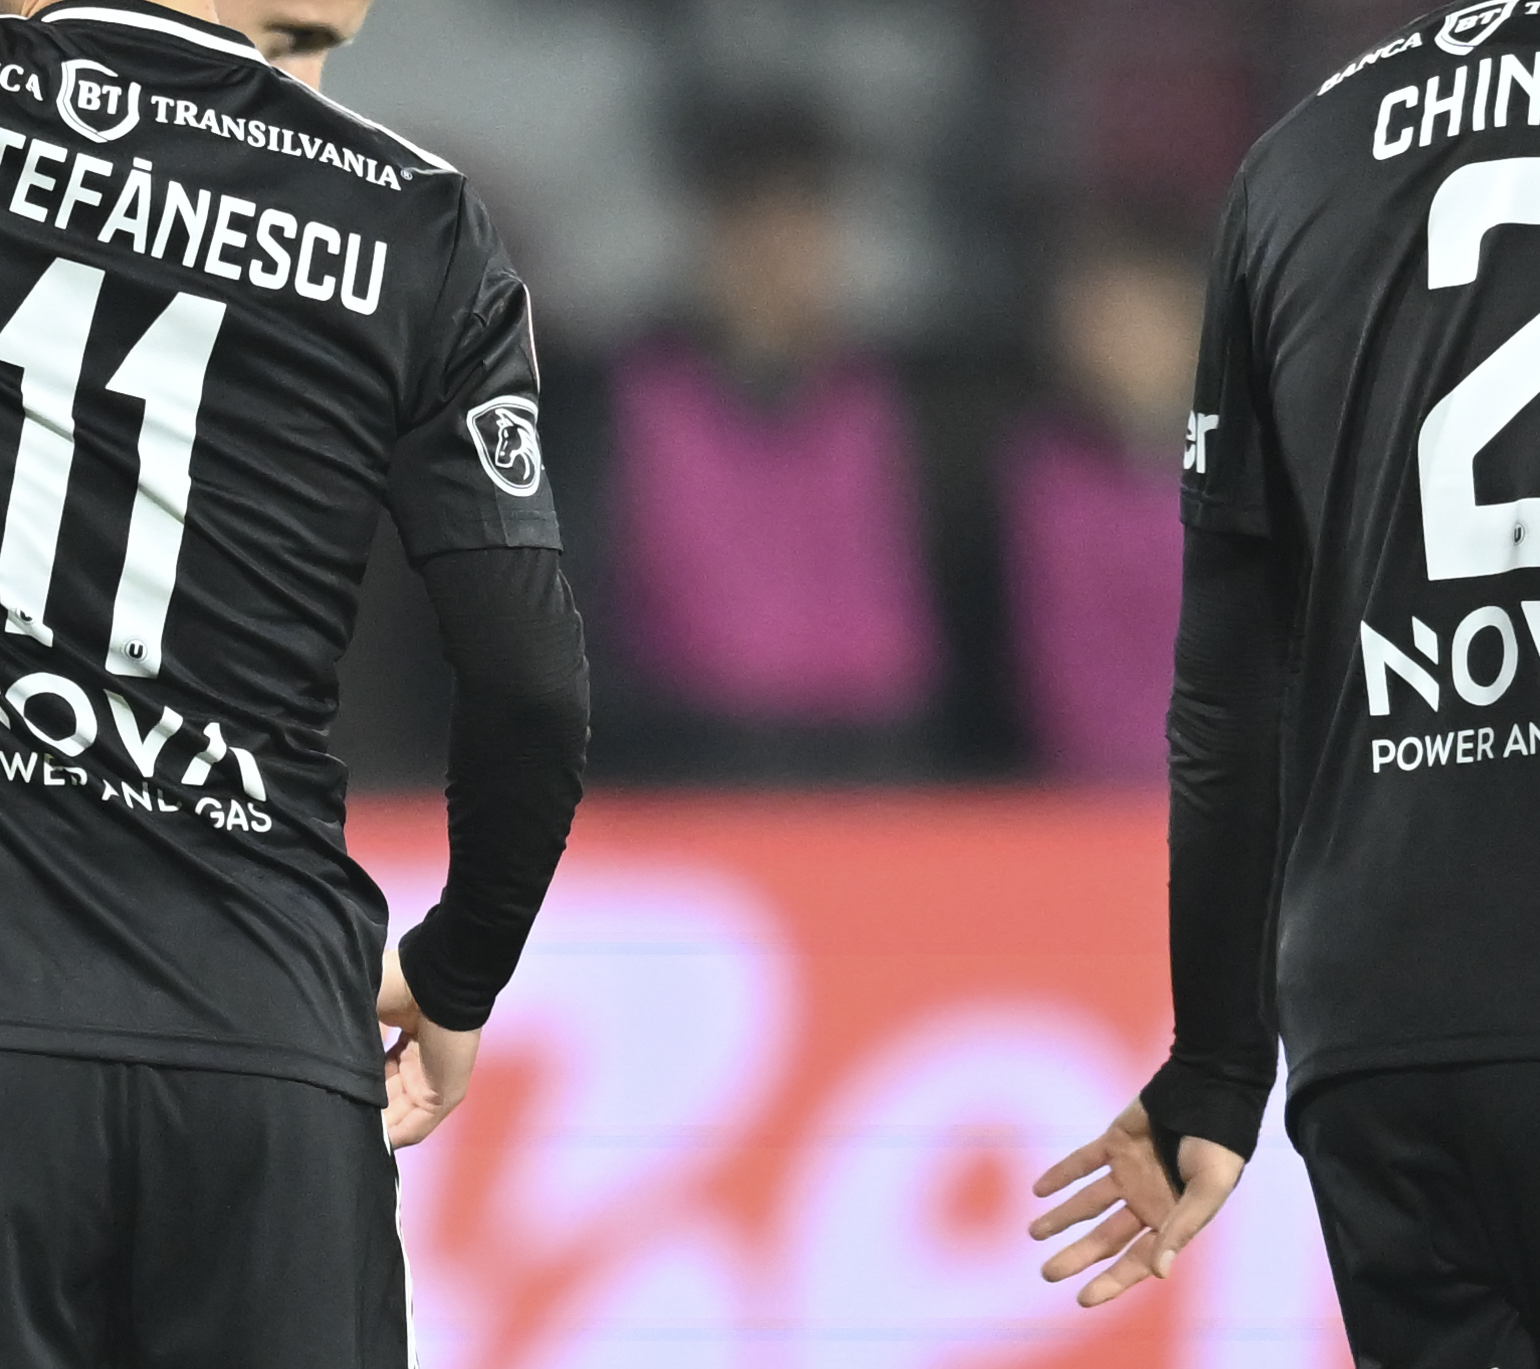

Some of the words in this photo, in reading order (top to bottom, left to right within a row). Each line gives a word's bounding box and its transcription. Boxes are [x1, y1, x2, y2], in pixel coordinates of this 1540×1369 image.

[77, 78, 123, 115] BT
[1372, 727, 1495, 773] POWER
[195, 797, 272, 833] GAS
